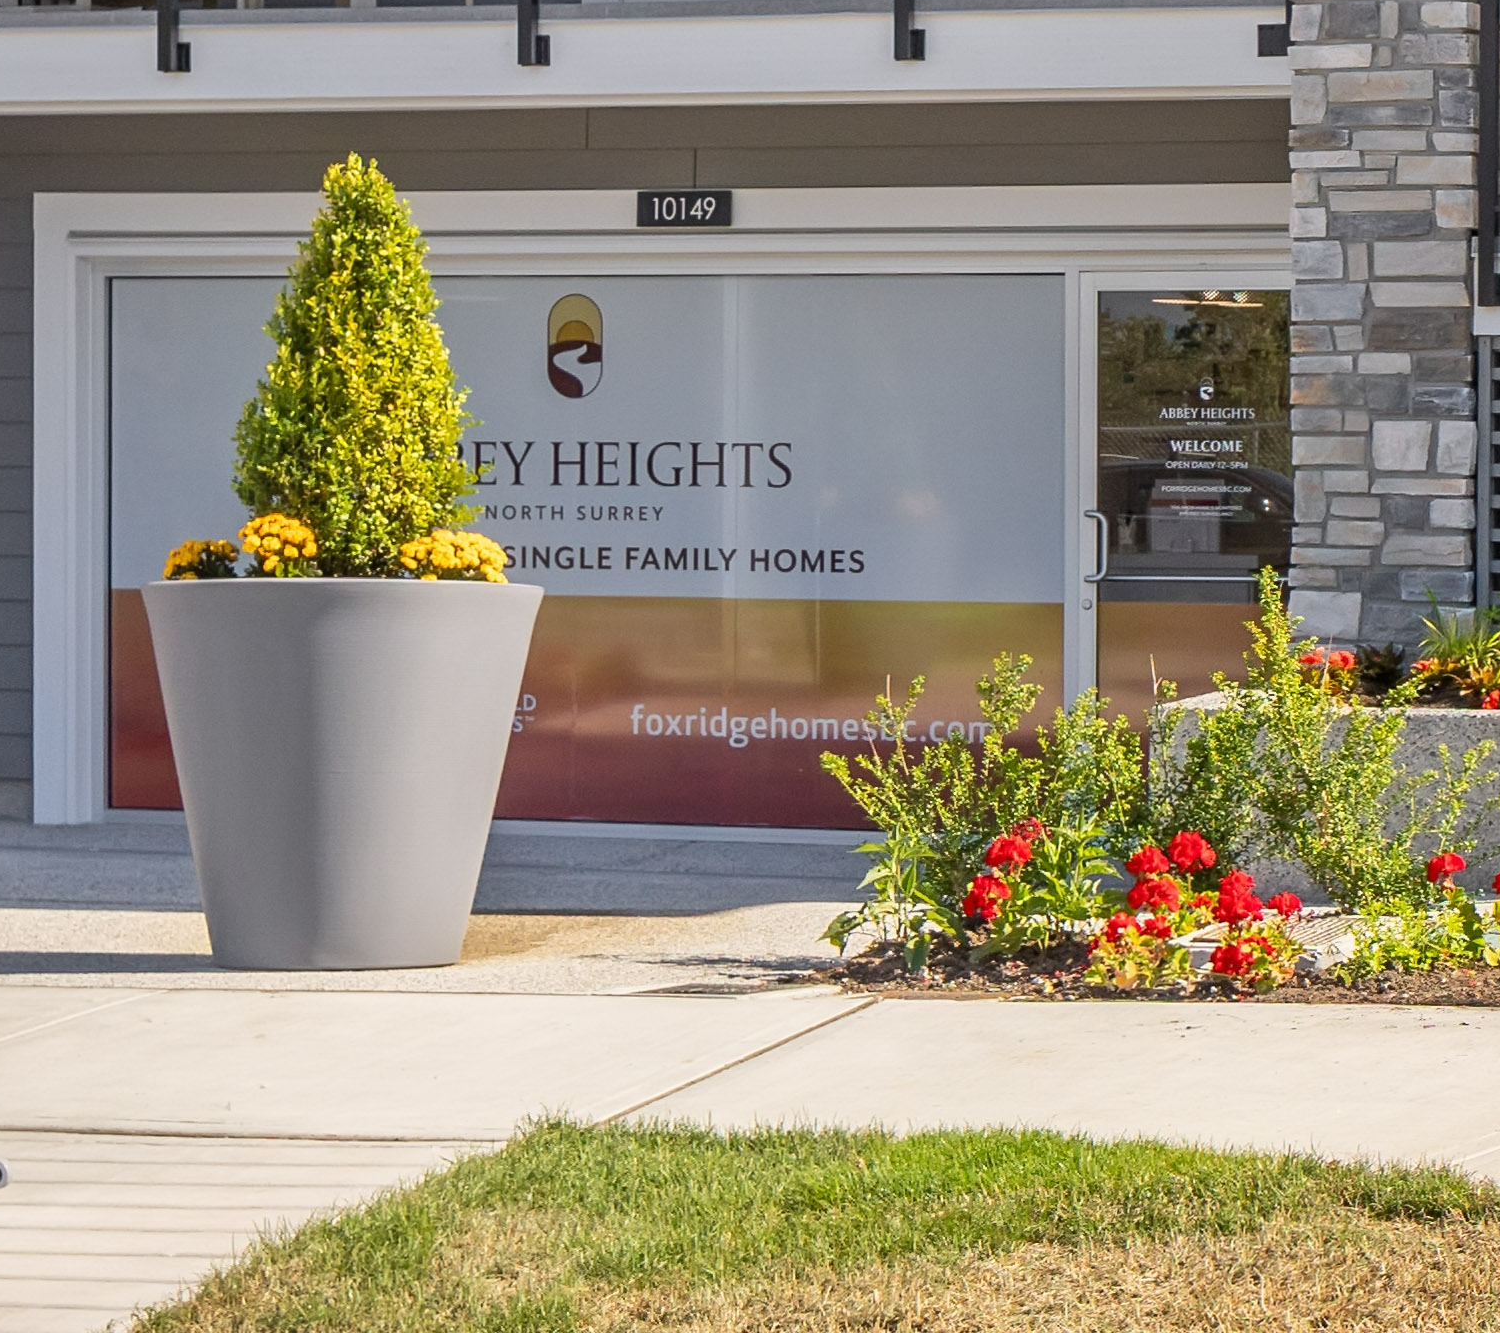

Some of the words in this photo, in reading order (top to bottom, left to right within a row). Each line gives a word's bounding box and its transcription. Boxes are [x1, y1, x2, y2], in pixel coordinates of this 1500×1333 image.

[651, 196, 717, 221] 10149
[1159, 407, 1199, 419] ABBEY
[1200, 407, 1256, 419] HEIGHTS
[1170, 440, 1244, 453] WELCOME
[550, 440, 793, 488] HEIGHTS
[1165, 461, 1189, 469] OPEN
[1191, 461, 1215, 469] DAILY
[484, 504, 565, 521] NORTH
[576, 505, 665, 522] SURREY
[501, 545, 613, 572] SINGLE
[625, 546, 738, 573] FAMILY
[749, 548, 865, 574] HOMES
